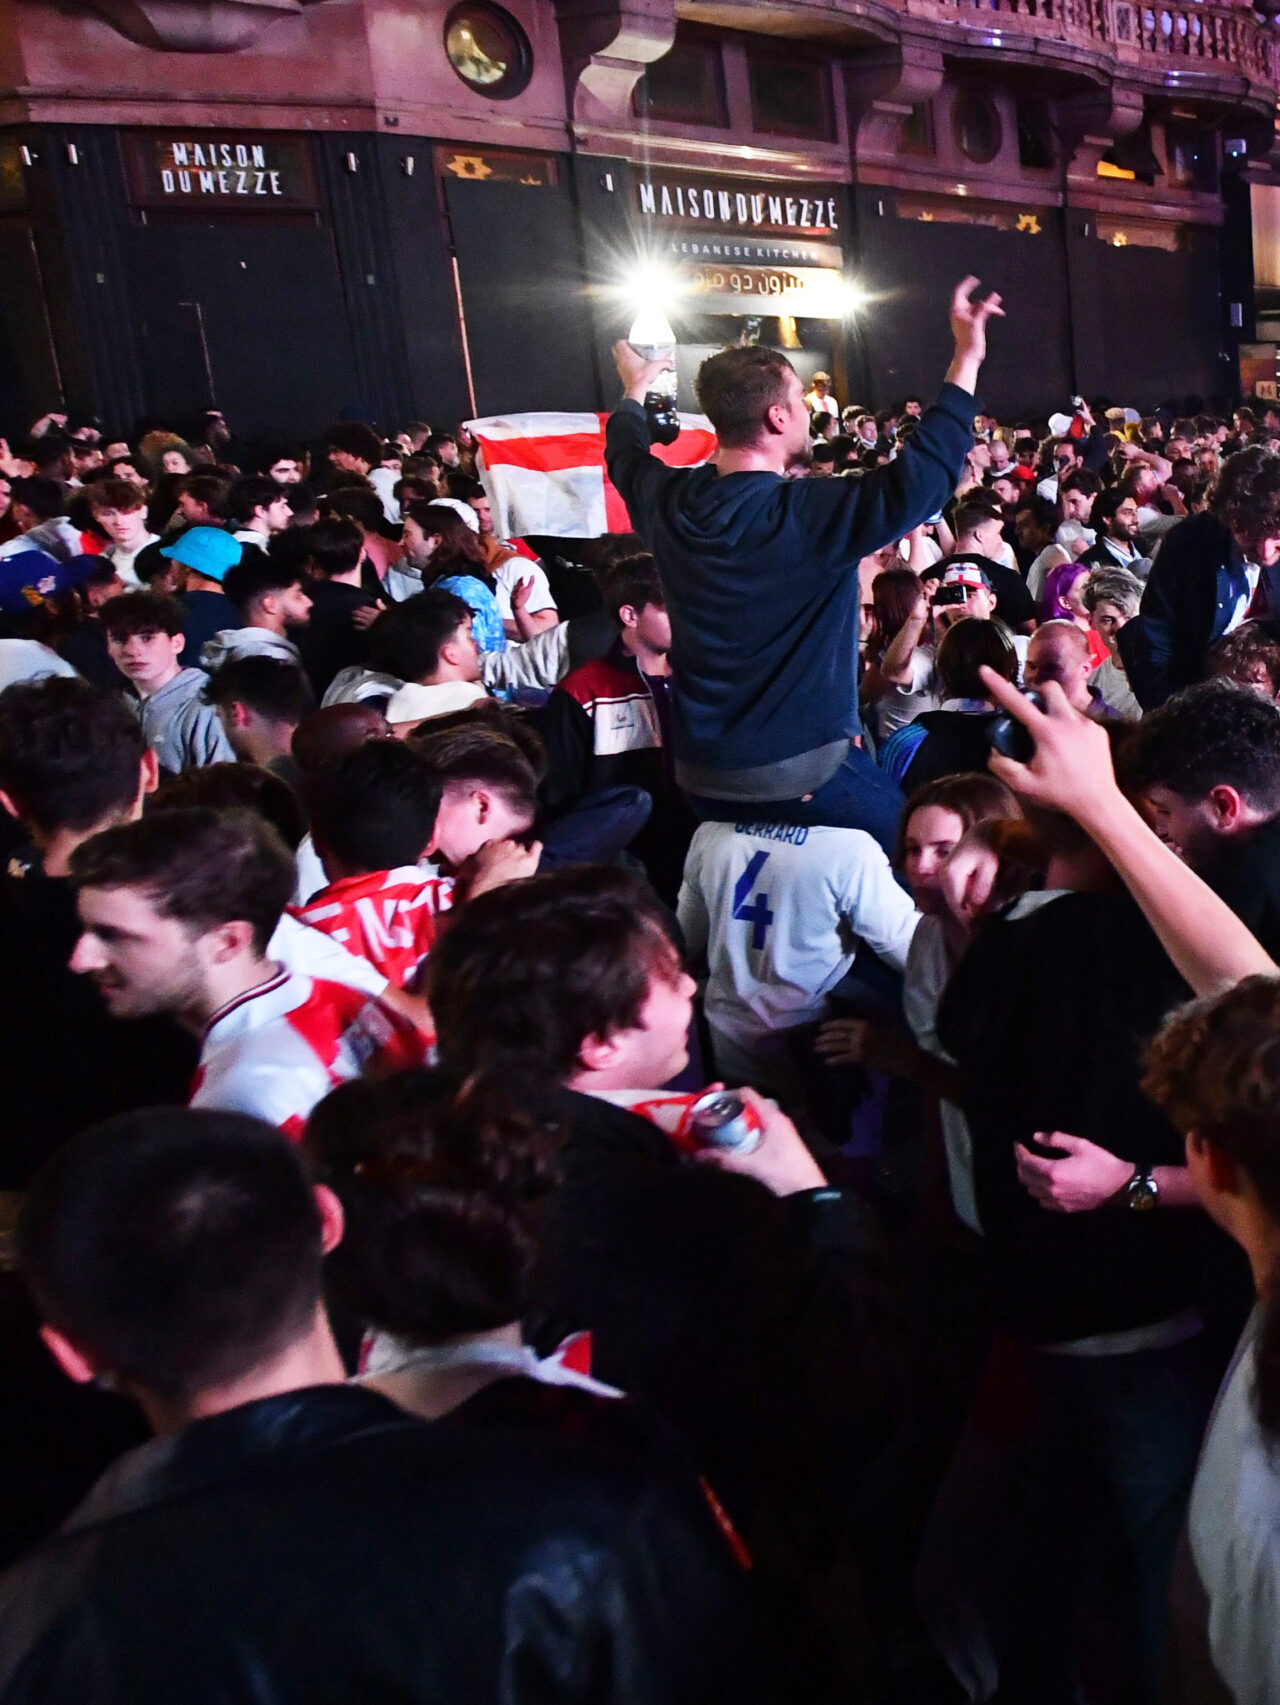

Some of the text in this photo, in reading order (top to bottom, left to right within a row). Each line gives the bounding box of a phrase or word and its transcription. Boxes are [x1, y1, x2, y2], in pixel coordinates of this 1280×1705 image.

[172, 142, 265, 168] MAISON
[162, 170, 192, 193] DU
[639, 183, 731, 221] MAISON
[736, 192, 763, 224] DU
[671, 242, 819, 260] LEBANESE KITCHEN
[733, 850, 774, 950] 4
